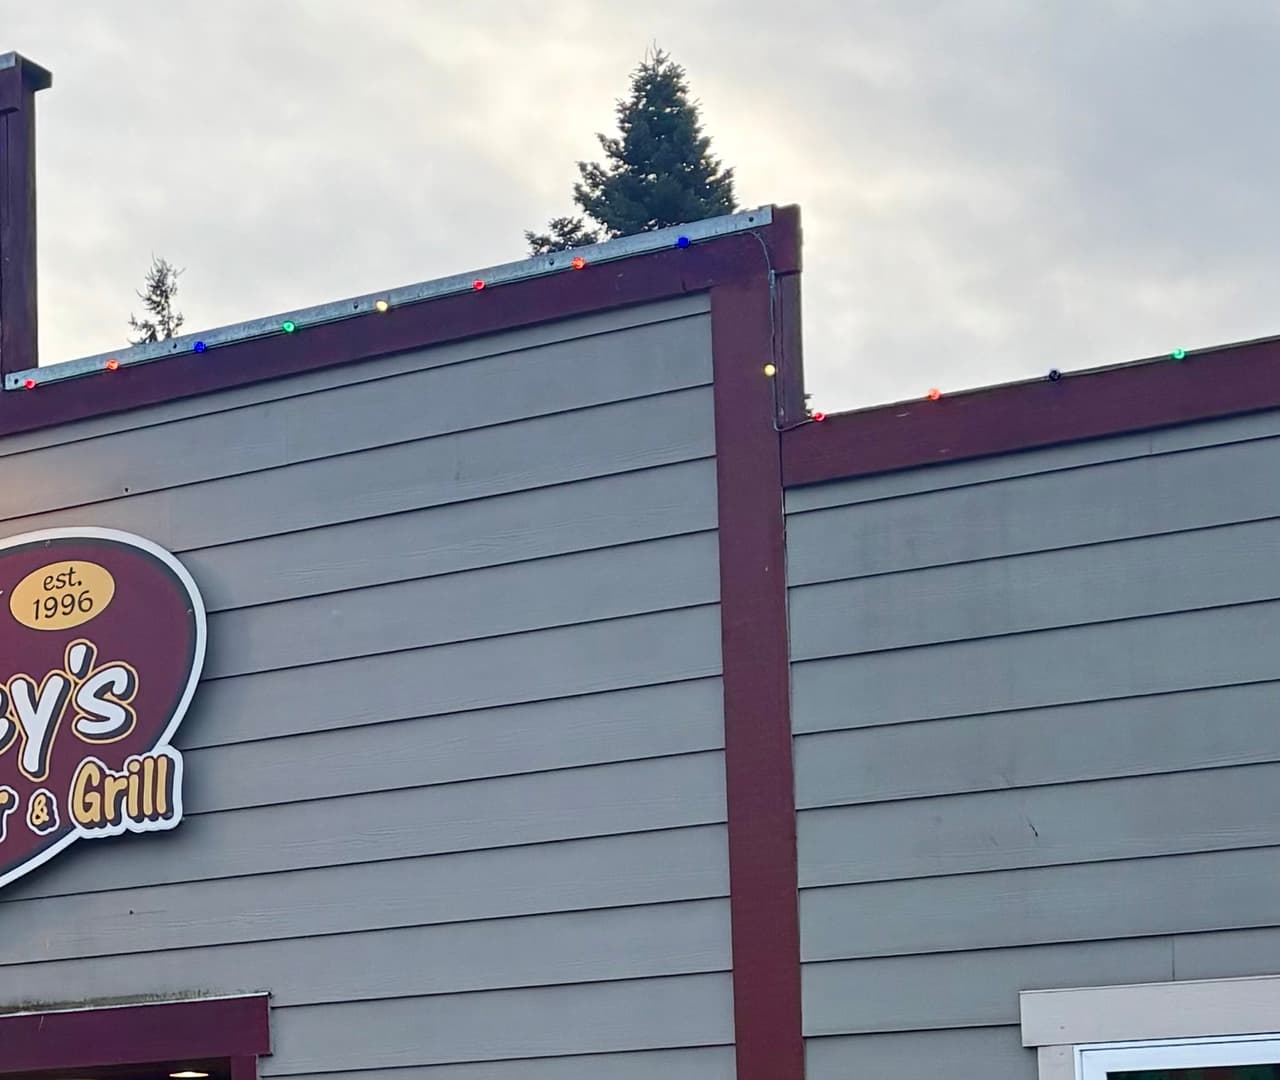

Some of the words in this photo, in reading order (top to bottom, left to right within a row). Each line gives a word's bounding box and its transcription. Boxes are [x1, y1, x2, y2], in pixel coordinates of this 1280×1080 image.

[42, 567, 83, 591] est.
[32, 594, 95, 621] 1996
[30, 796, 49, 827] &
[72, 755, 171, 827] Grill
